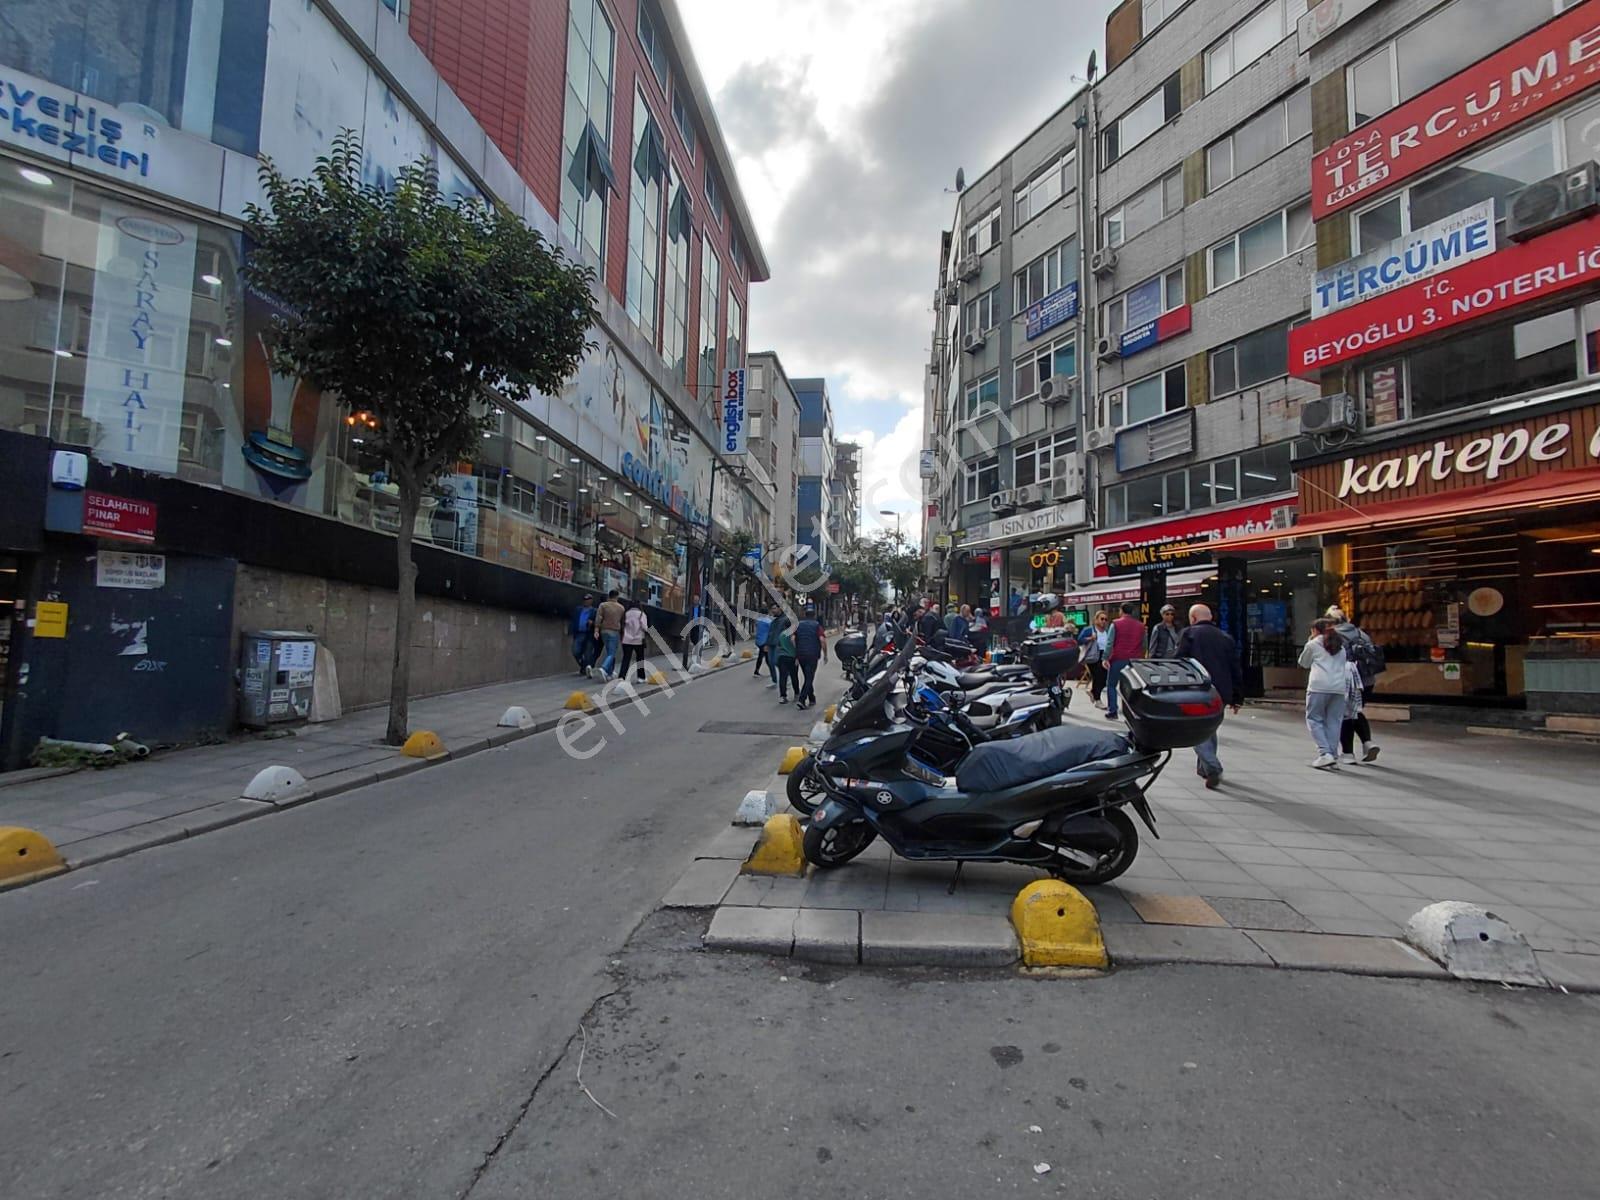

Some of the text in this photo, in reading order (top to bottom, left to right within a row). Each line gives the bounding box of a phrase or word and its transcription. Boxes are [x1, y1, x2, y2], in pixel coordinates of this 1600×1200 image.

[1326, 25, 1600, 189] TERCÜME
[1325, 130, 1381, 166] LOSA
[1317, 219, 1489, 308] TERCÜME
[131, 250, 160, 350] SARAY
[1423, 280, 1454, 300] T.C.
[1303, 313, 1414, 366] BEYOĞLU
[1421, 308, 1443, 326] 3.
[724, 370, 741, 452] englishbox
[1338, 423, 1570, 498] kartepe
[88, 496, 150, 516] SELAHATTİN
[88, 508, 120, 522] PINAR
[1028, 508, 1064, 530] OPTİK
[1120, 547, 1148, 566] DARK
